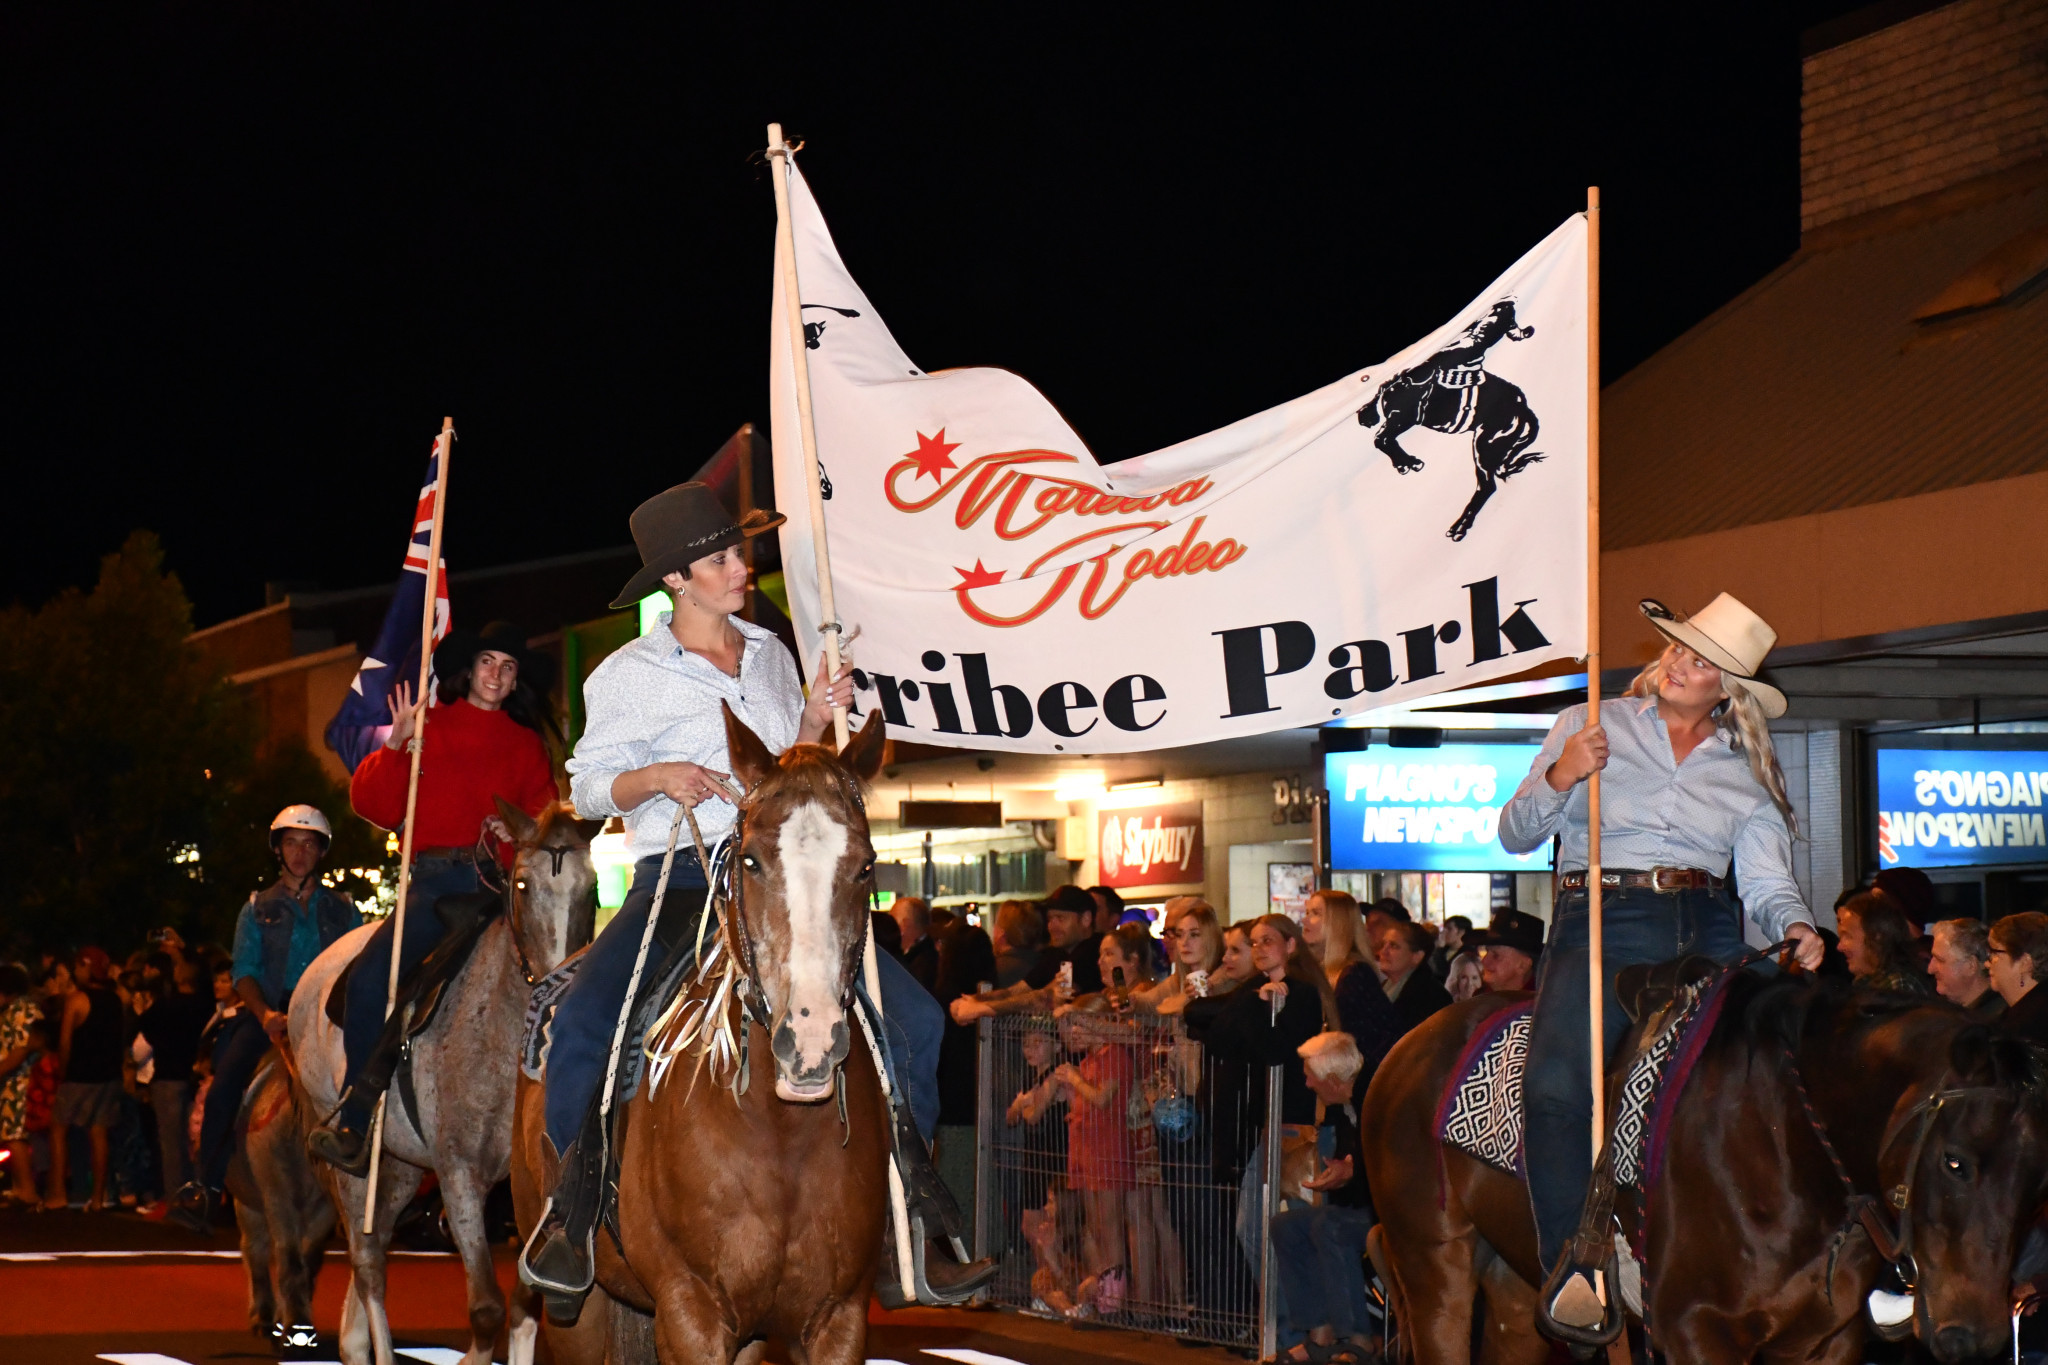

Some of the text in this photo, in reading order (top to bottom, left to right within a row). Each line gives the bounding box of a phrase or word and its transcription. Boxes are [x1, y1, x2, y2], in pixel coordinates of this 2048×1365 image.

[955, 516, 1247, 628] Rodeo
[1211, 575, 1552, 719] Park
[1345, 764, 1497, 802] PIAGNO'S
[1123, 816, 1196, 874] Skybury
[1362, 806, 1503, 844] NEWSPO
